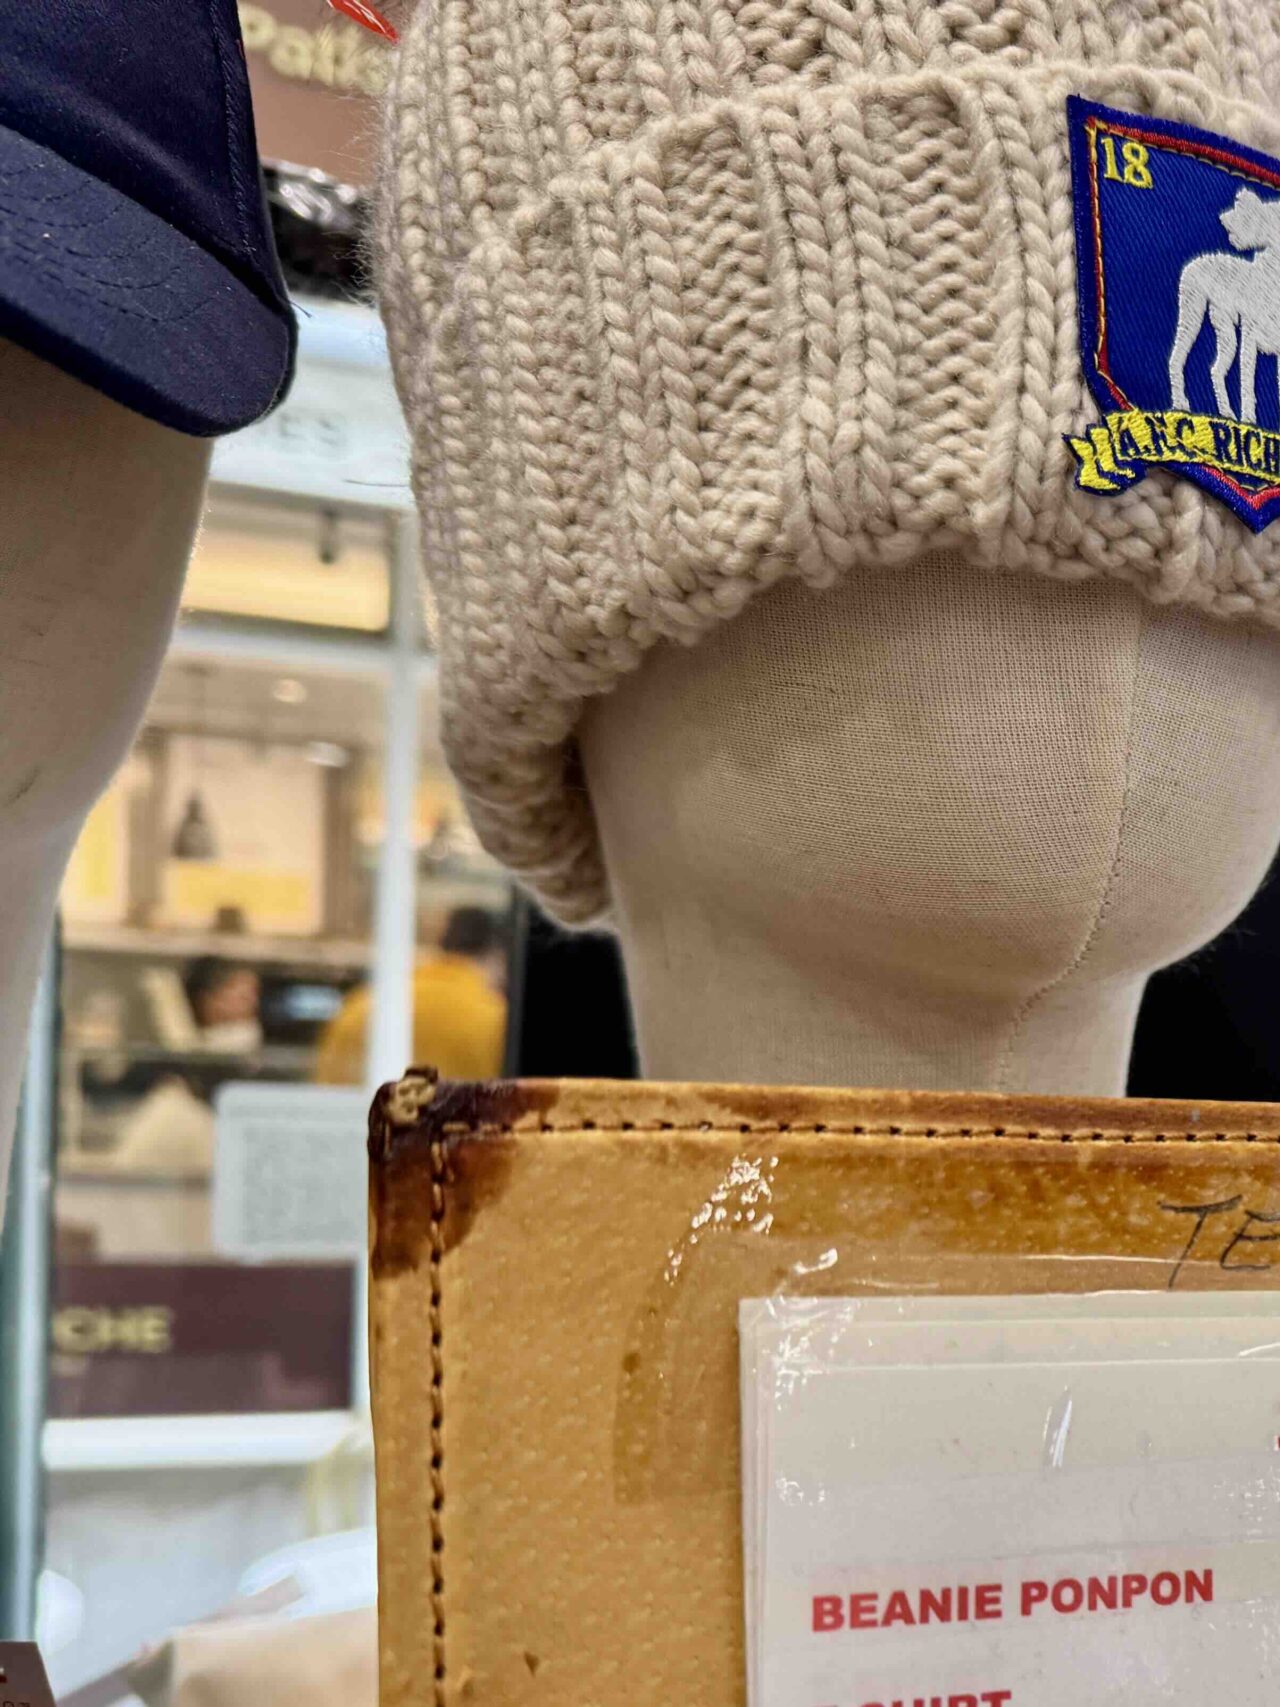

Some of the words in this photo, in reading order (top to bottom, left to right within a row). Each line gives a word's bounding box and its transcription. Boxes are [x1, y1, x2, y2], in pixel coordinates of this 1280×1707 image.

[1101, 137, 1154, 190] 18
[811, 1583, 1004, 1633] BEANIE
[1019, 1569, 1214, 1617] PONPON
